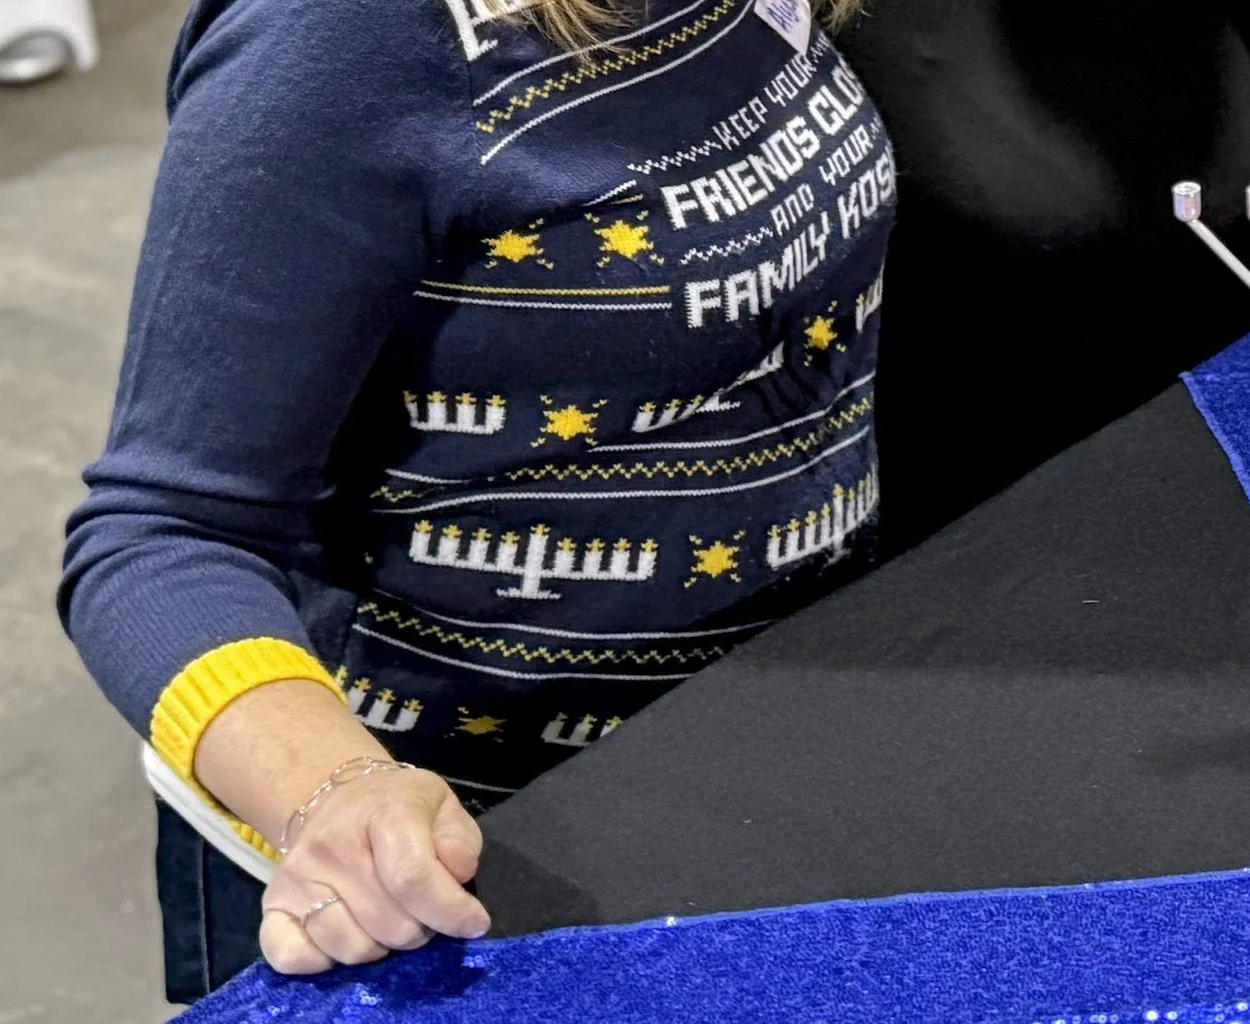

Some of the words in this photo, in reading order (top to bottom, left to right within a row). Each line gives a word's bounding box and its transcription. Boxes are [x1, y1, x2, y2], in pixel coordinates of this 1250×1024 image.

[713, 95, 768, 151] KEEP
[764, 52, 817, 107] YOUR
[660, 116, 821, 231] FRIENDS
[770, 183, 815, 237] AND
[819, 124, 874, 186] YOUR
[684, 211, 831, 329] FAMILY
